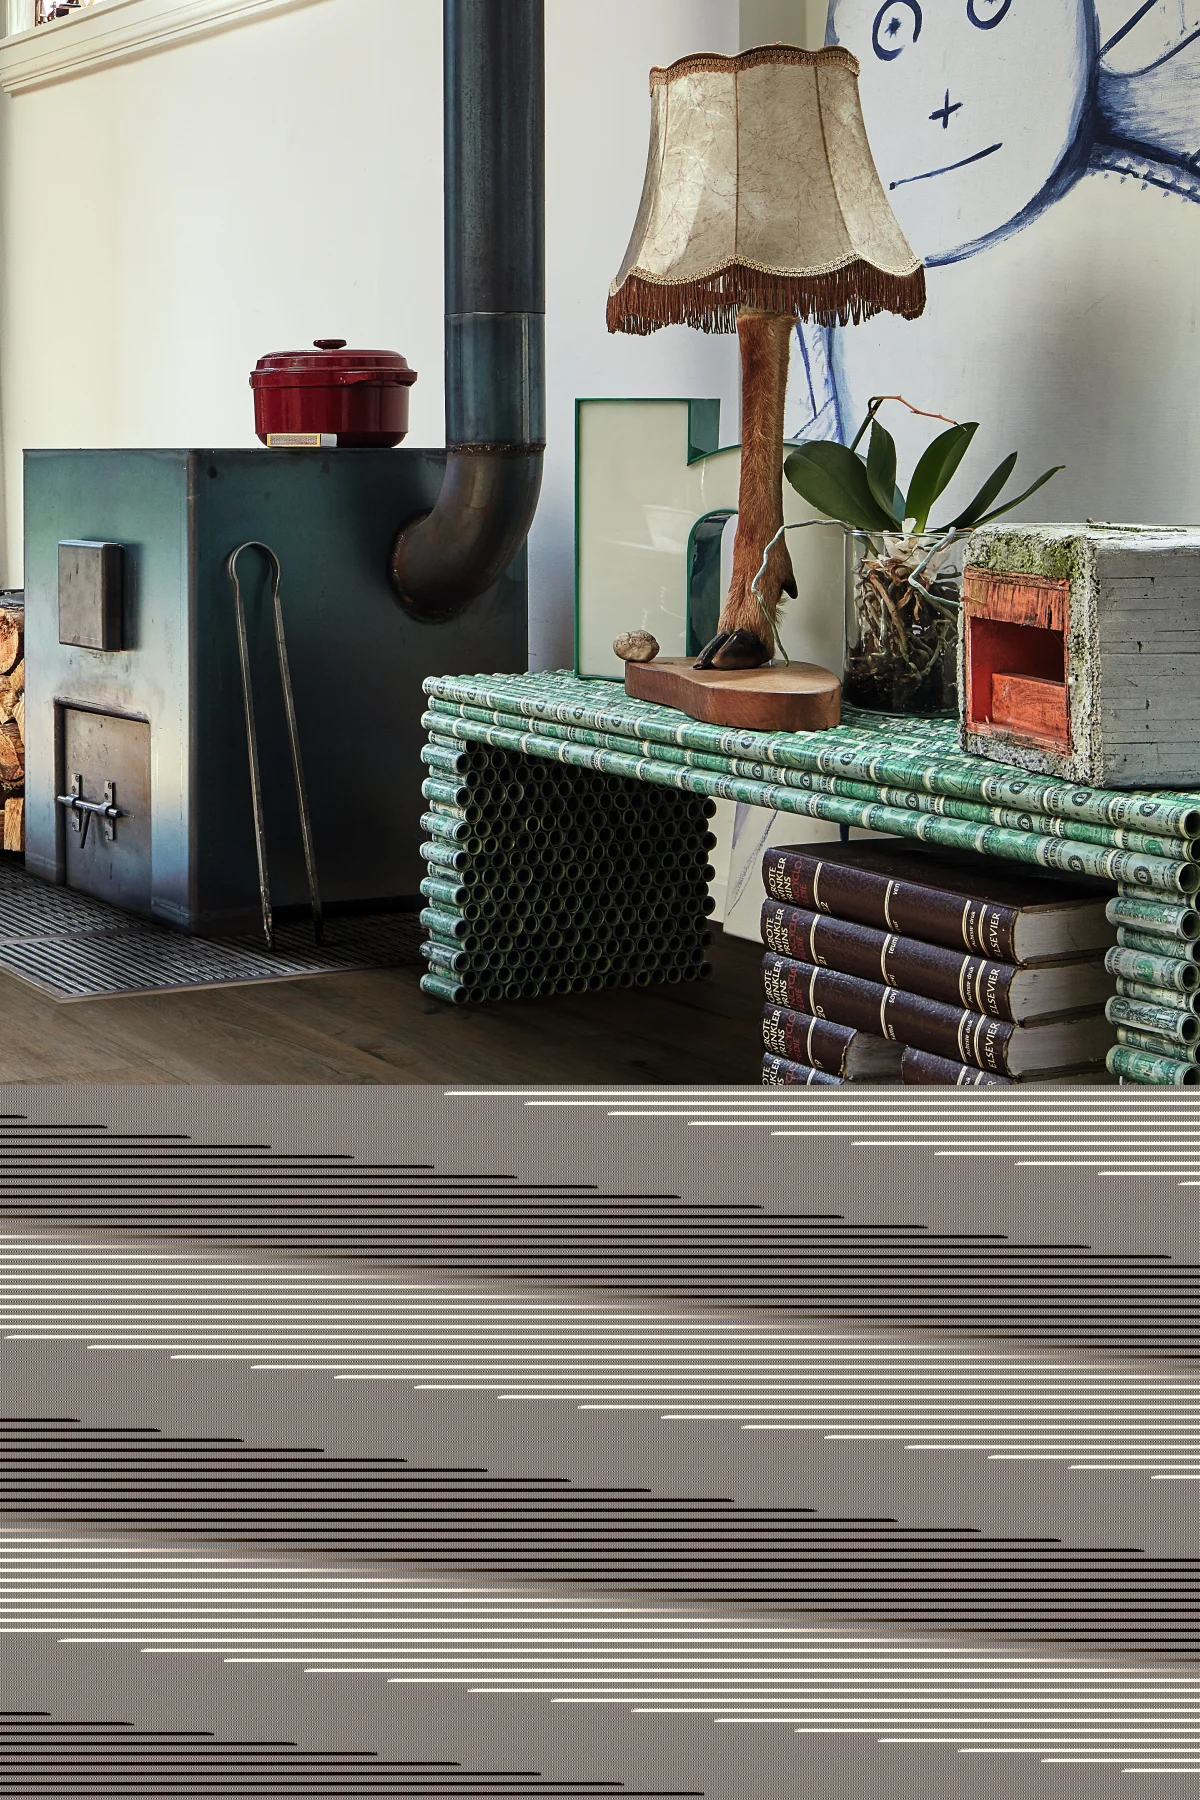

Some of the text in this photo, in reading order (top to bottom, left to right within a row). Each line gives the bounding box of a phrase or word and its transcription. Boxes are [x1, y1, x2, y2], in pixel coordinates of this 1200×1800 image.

[769, 866, 780, 899] GROTE
[776, 857, 788, 900] WINKLER
[892, 882, 900, 896] ven
[766, 916, 776, 951] GROTE
[774, 908, 785, 952] WINKLER
[782, 927, 792, 956] PRINS
[989, 912, 1004, 958] ELSEVIER
[764, 969, 776, 1003] GROTE
[772, 960, 783, 1005] WINKLER
[780, 980, 792, 1008] PRINS
[986, 968, 1000, 1014] ELSEVIER
[816, 1005, 826, 1019] 20
[966, 1019, 974, 1032] druk
[762, 1018, 774, 1052] GROTE
[770, 1009, 782, 1053] WINKLER
[778, 1028, 789, 1057] PRINS
[984, 1022, 1000, 1068] ELSEVIER
[762, 1067, 771, 1085] OTE
[770, 1058, 782, 1085] NKLER
[814, 1058, 824, 1069] 19
